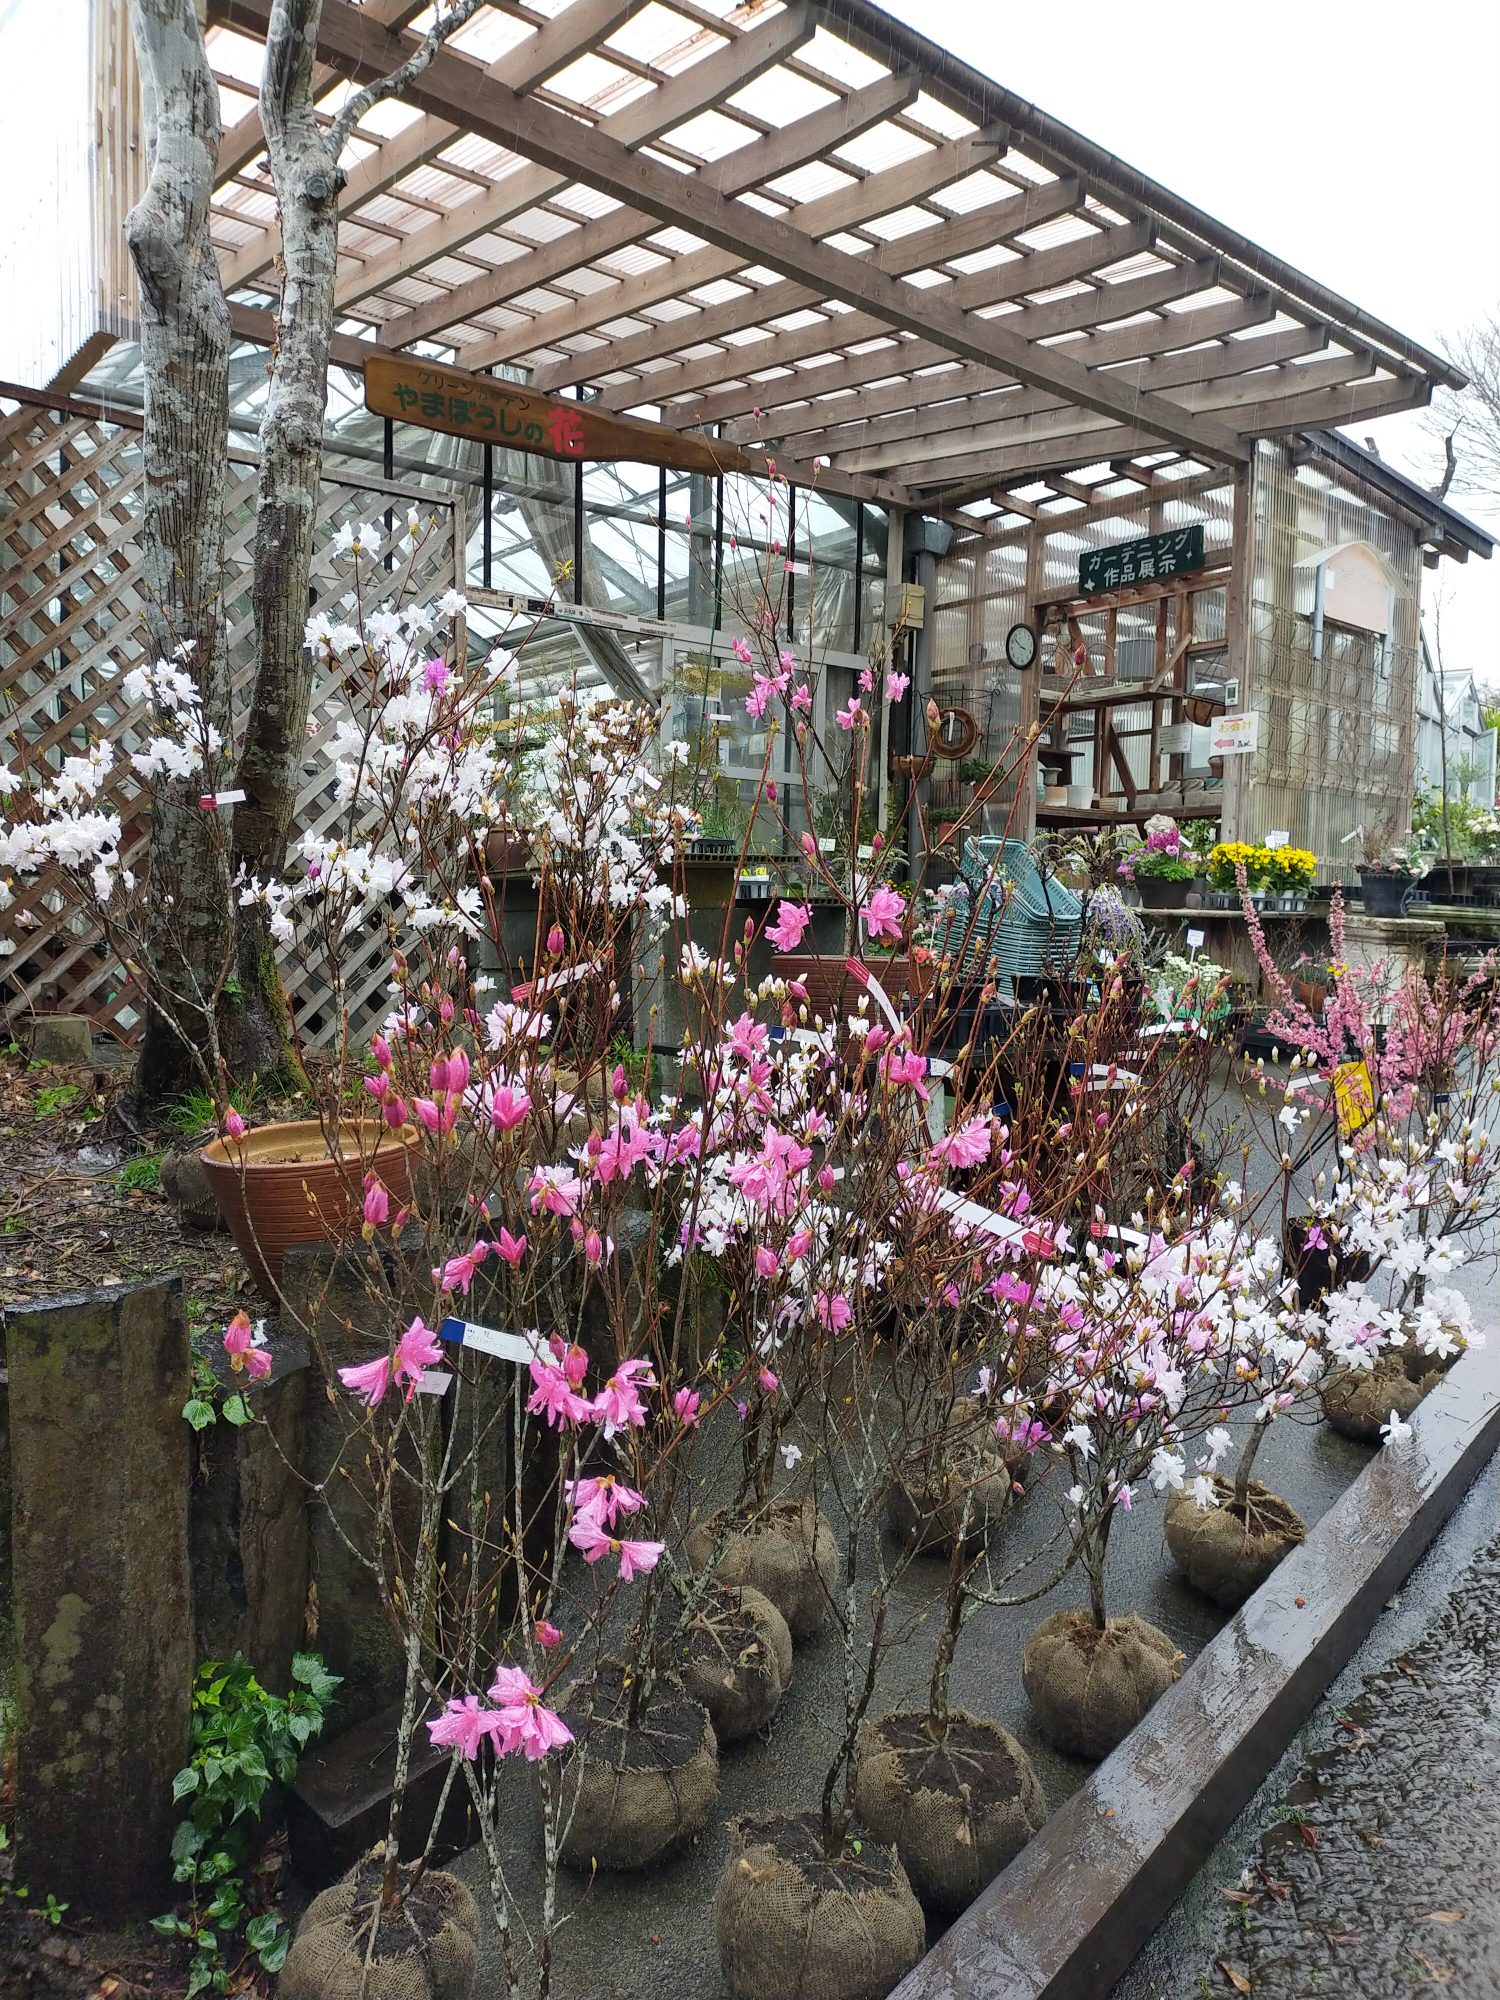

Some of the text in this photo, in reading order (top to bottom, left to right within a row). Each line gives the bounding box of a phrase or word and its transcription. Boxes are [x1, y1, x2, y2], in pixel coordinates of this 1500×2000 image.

[394, 383, 584, 455] やまぼうしの花
[1089, 530, 1189, 571] ガーデニング
[1103, 554, 1177, 588] 作品展示
